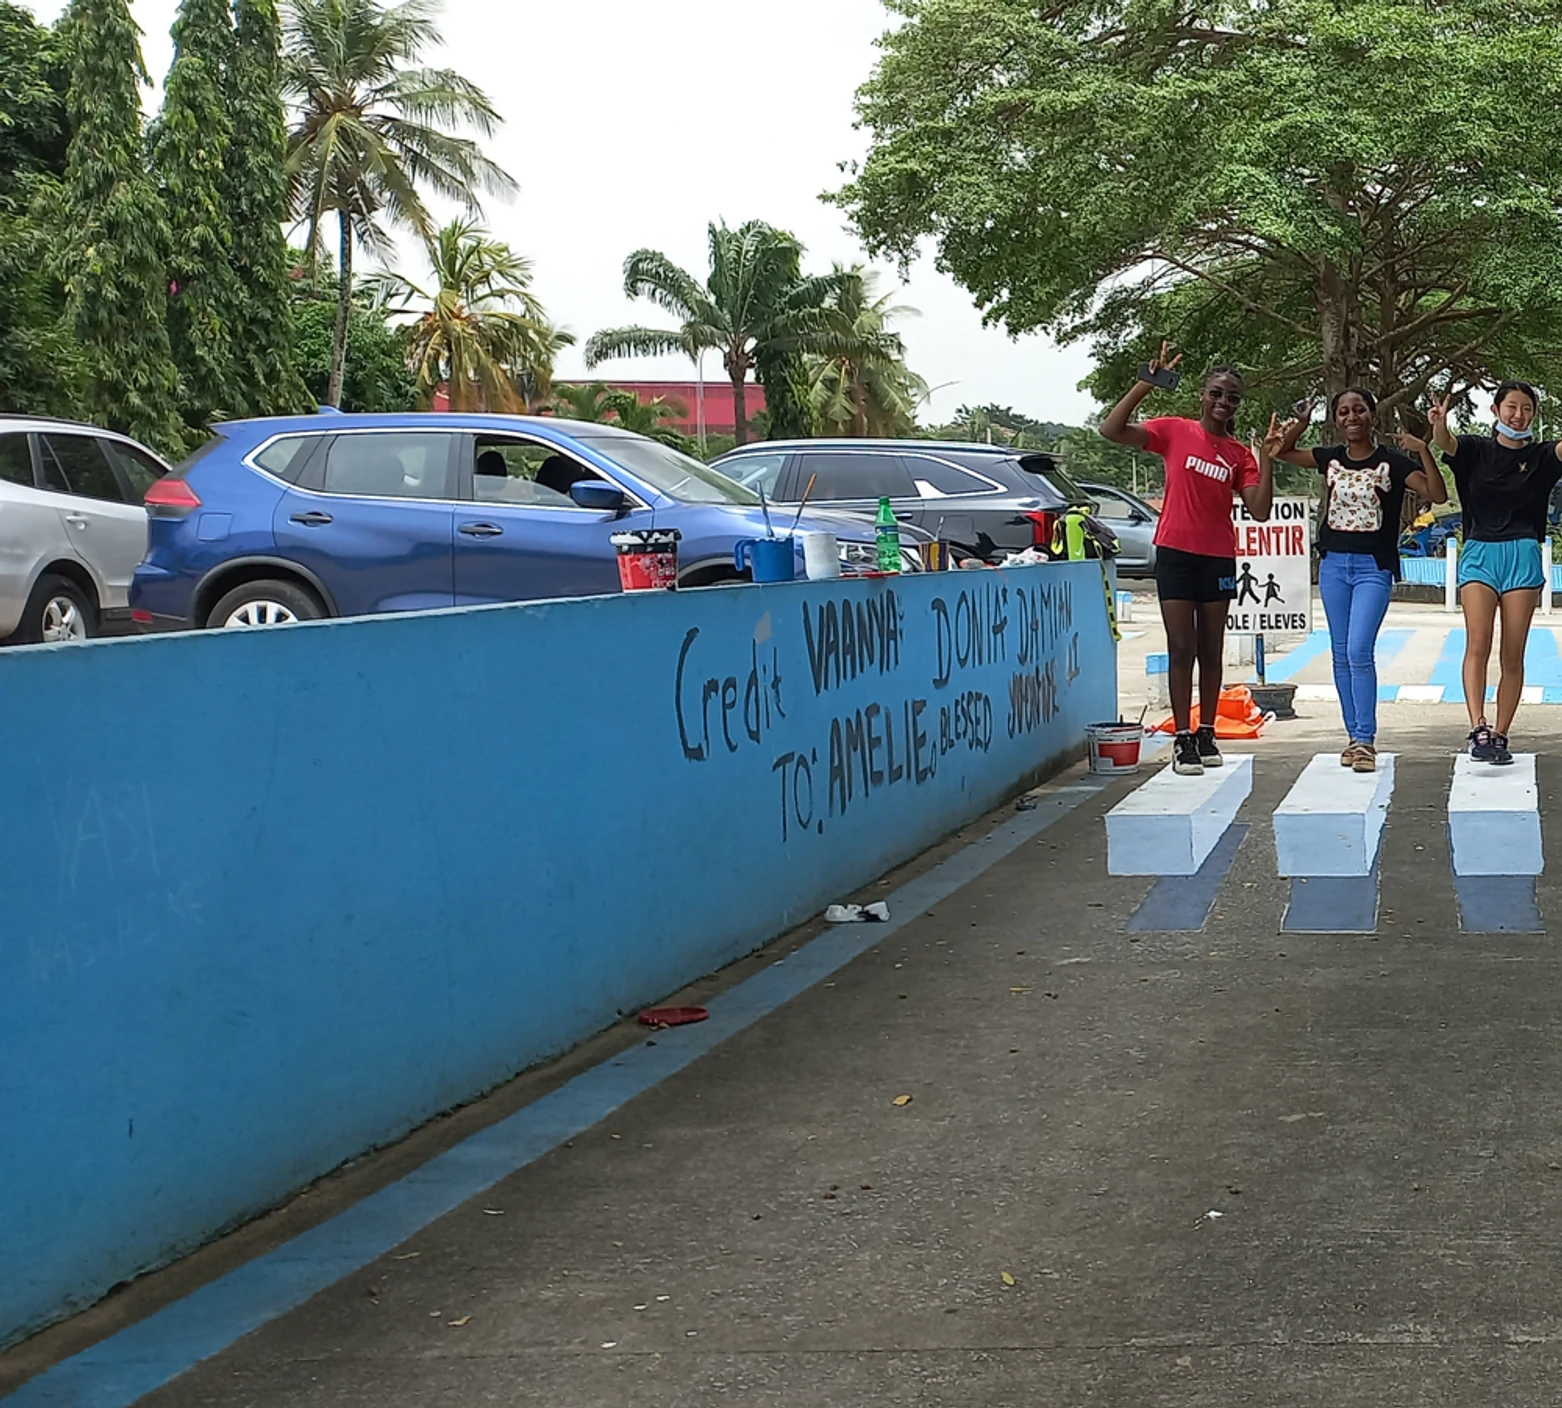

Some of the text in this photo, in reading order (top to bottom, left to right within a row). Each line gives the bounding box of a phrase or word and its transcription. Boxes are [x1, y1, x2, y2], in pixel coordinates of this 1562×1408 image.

[1185, 455, 1229, 483] PUMA
[1232, 501, 1304, 521] TEION
[1234, 525, 1305, 557] LENTIR
[1226, 613, 1249, 630] OLE
[1259, 613, 1307, 630] ELEVES
[674, 626, 787, 763] Credit
[1016, 580, 1072, 667] DAMIAN
[940, 690, 993, 756] BLESSED
